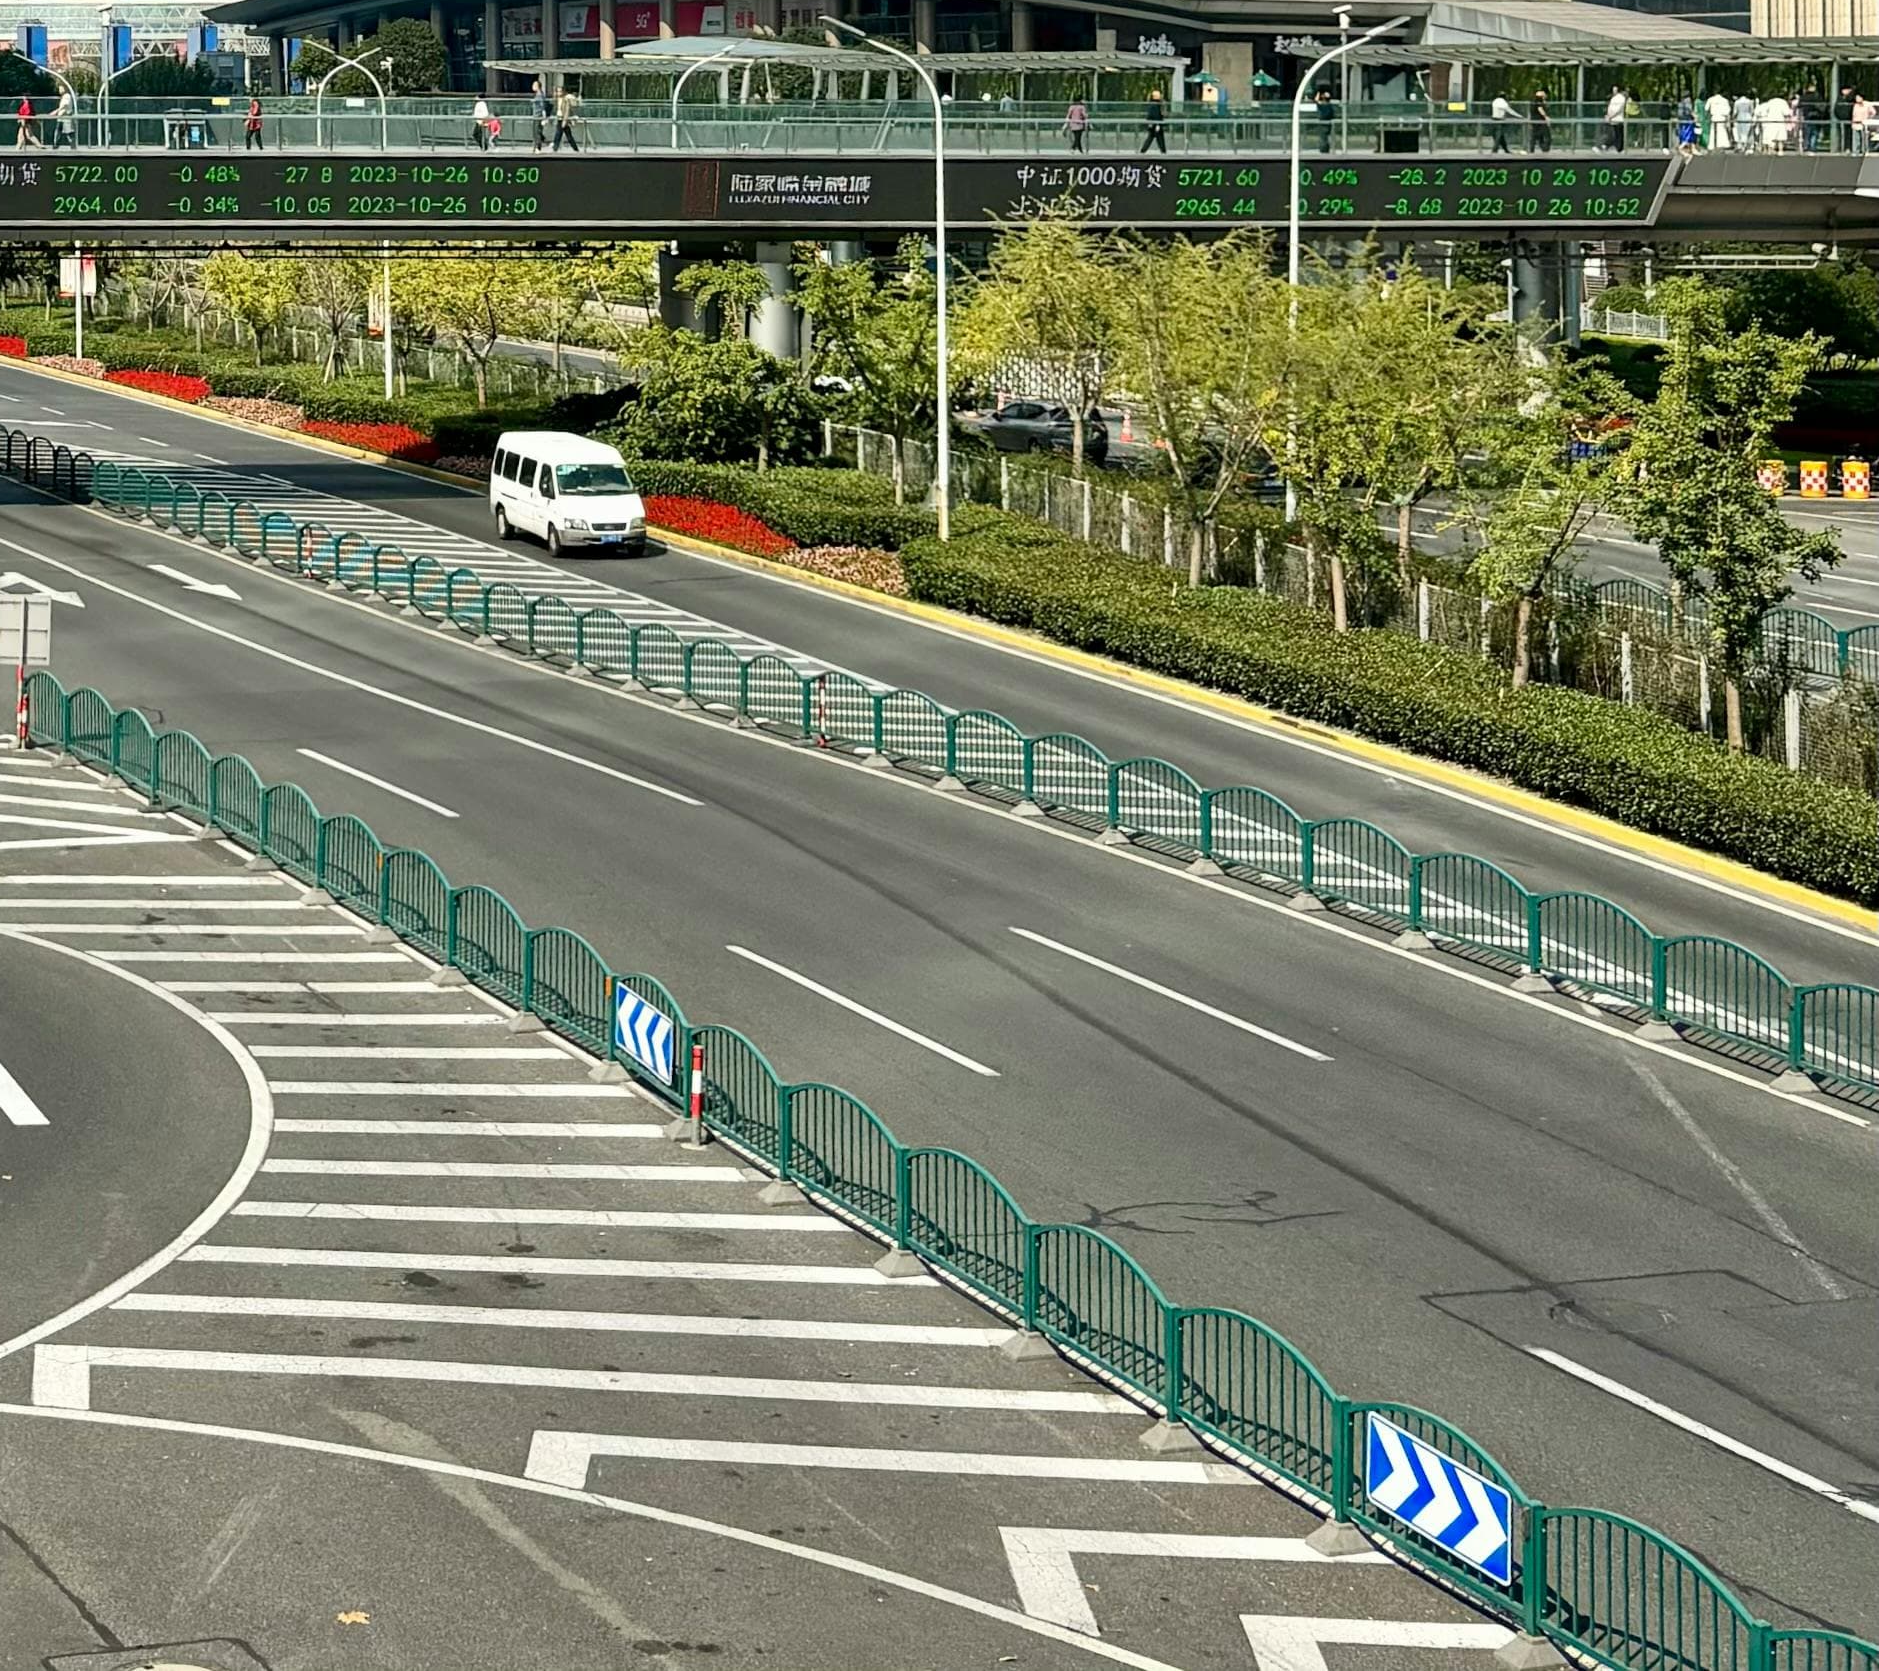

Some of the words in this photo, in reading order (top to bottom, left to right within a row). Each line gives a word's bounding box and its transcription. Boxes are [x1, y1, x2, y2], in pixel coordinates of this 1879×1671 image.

[55, 166, 138, 183] 5722.00
[350, 166, 468, 184] 2023-10-26
[482, 166, 540, 185] 10:50
[1177, 168, 1260, 186] 5721.60
[1288, 169, 1358, 186] 0.49%
[1588, 168, 1644, 186] 10:52
[54, 196, 138, 214] 2964.06
[260, 196, 331, 213] -10.05
[348, 196, 467, 213] 2023-10-26
[480, 196, 538, 214] 10:50
[1175, 198, 1256, 216] 2965.44
[1384, 198, 1442, 215] -8.68
[1584, 198, 1640, 216] 10:52
